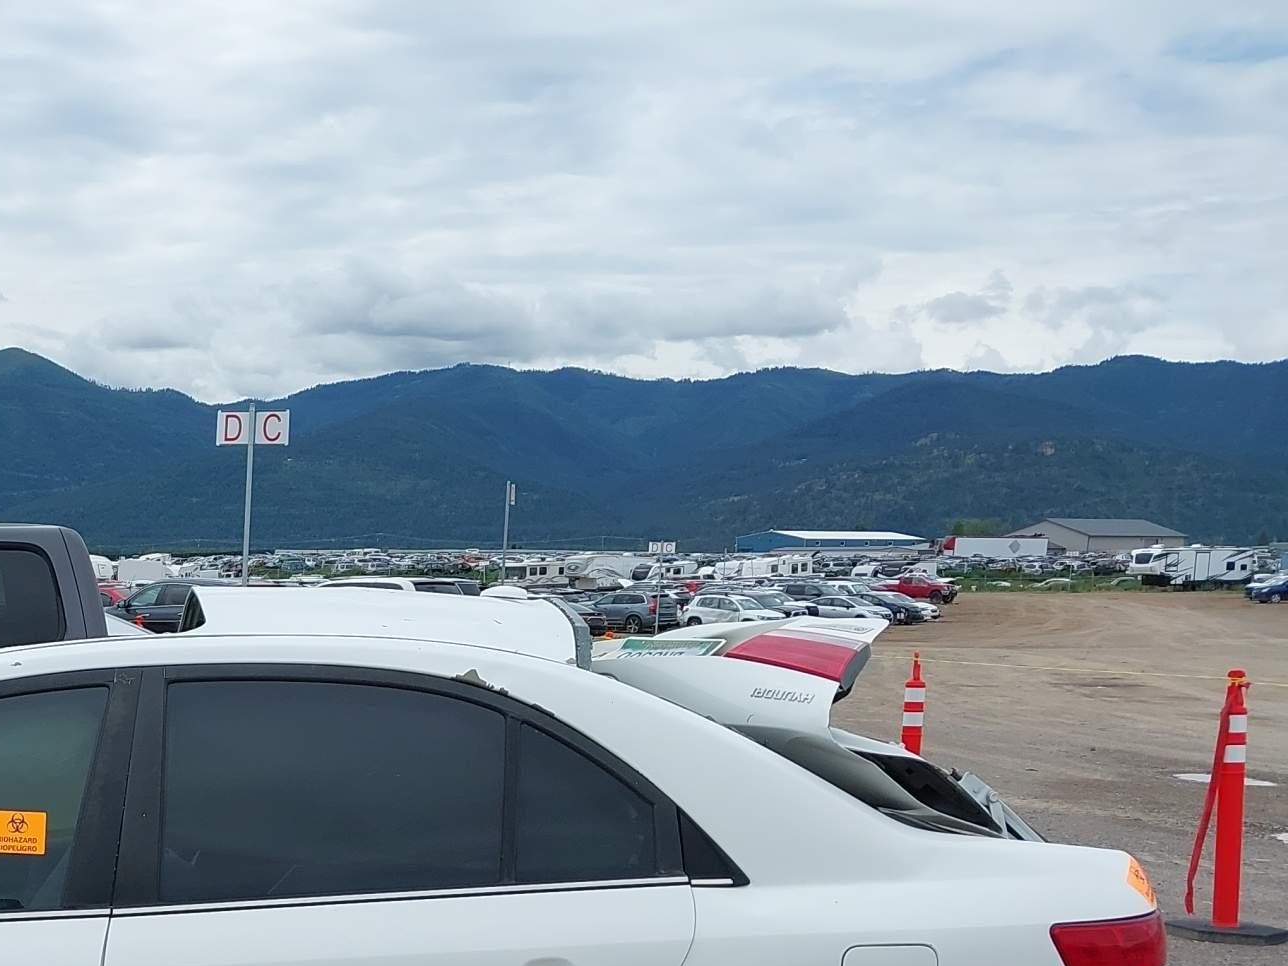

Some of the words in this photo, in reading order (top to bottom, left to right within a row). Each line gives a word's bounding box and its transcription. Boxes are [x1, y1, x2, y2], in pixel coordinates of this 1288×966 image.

[223, 414, 243, 442] D
[263, 413, 282, 442] C
[651, 542, 659, 553] D
[665, 543, 673, 553] C
[750, 687, 815, 704] HYUNDAI
